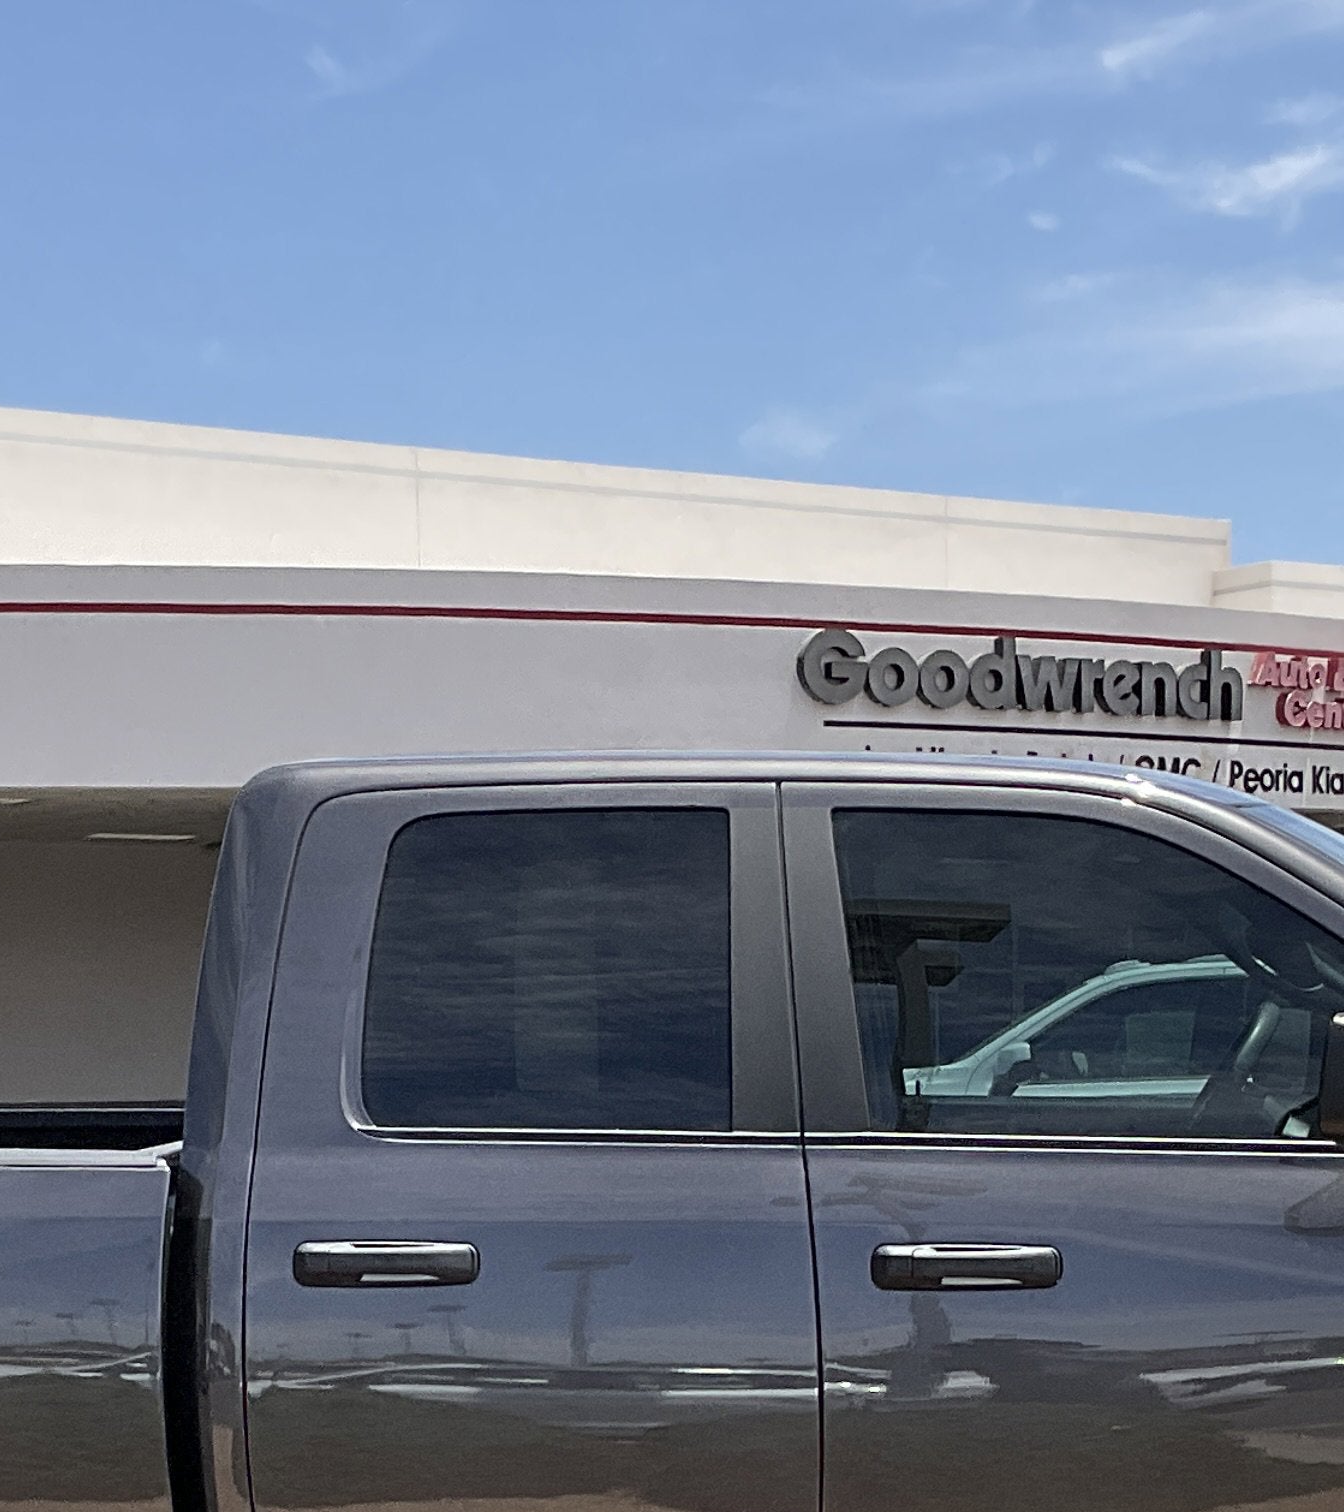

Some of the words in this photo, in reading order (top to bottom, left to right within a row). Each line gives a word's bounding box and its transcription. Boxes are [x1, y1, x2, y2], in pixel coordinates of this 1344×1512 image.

[796, 627, 1244, 722] Goodwrench
[1248, 651, 1327, 691] Auto
[1229, 760, 1303, 794] Peoria
